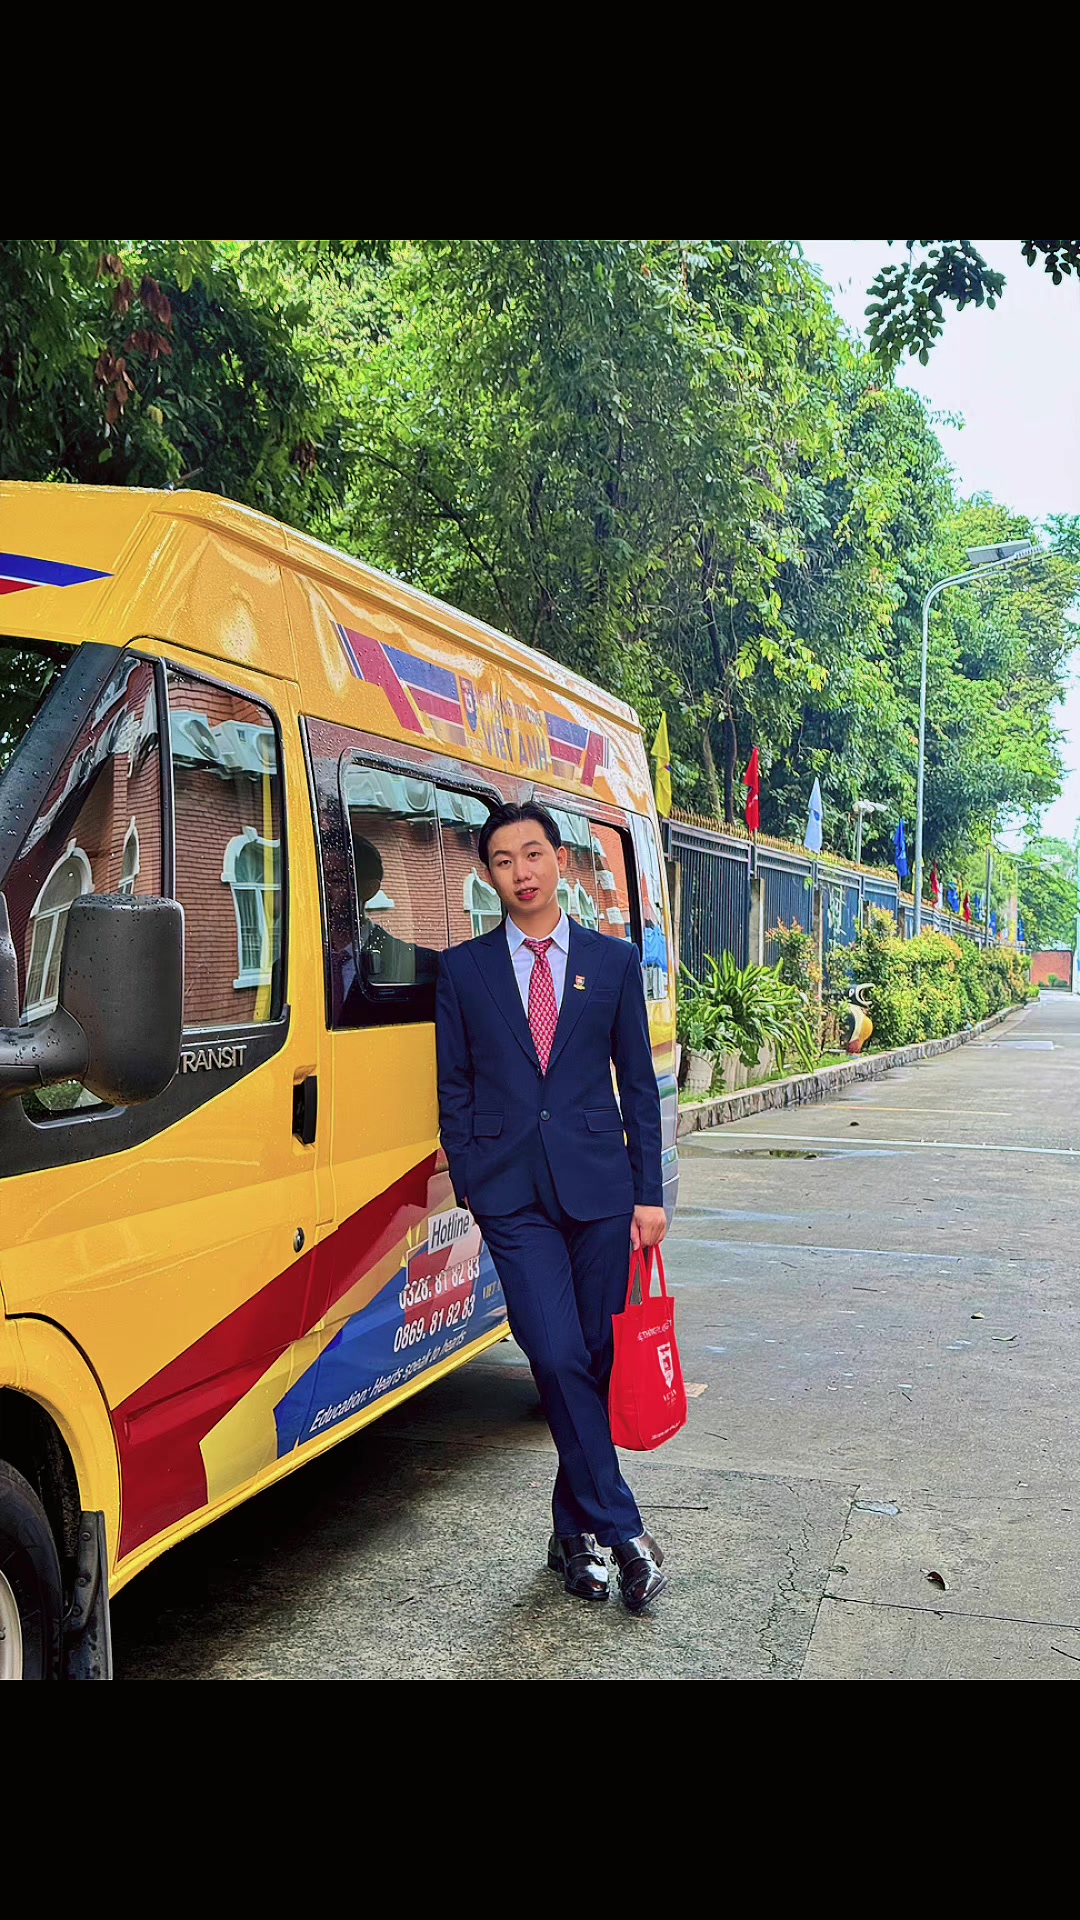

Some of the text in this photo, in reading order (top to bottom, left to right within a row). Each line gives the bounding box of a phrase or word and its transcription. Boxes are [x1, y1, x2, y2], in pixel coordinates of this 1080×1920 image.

[180, 1044, 247, 1074] RANSIT
[431, 1212, 470, 1249] Hotline
[434, 1269, 449, 1295] 81
[451, 1262, 466, 1289] 82
[467, 1256, 480, 1281] 83
[393, 1294, 476, 1353] 0869. 81 82 83
[309, 1330, 468, 1433] Education: Hearts speak to hearts
